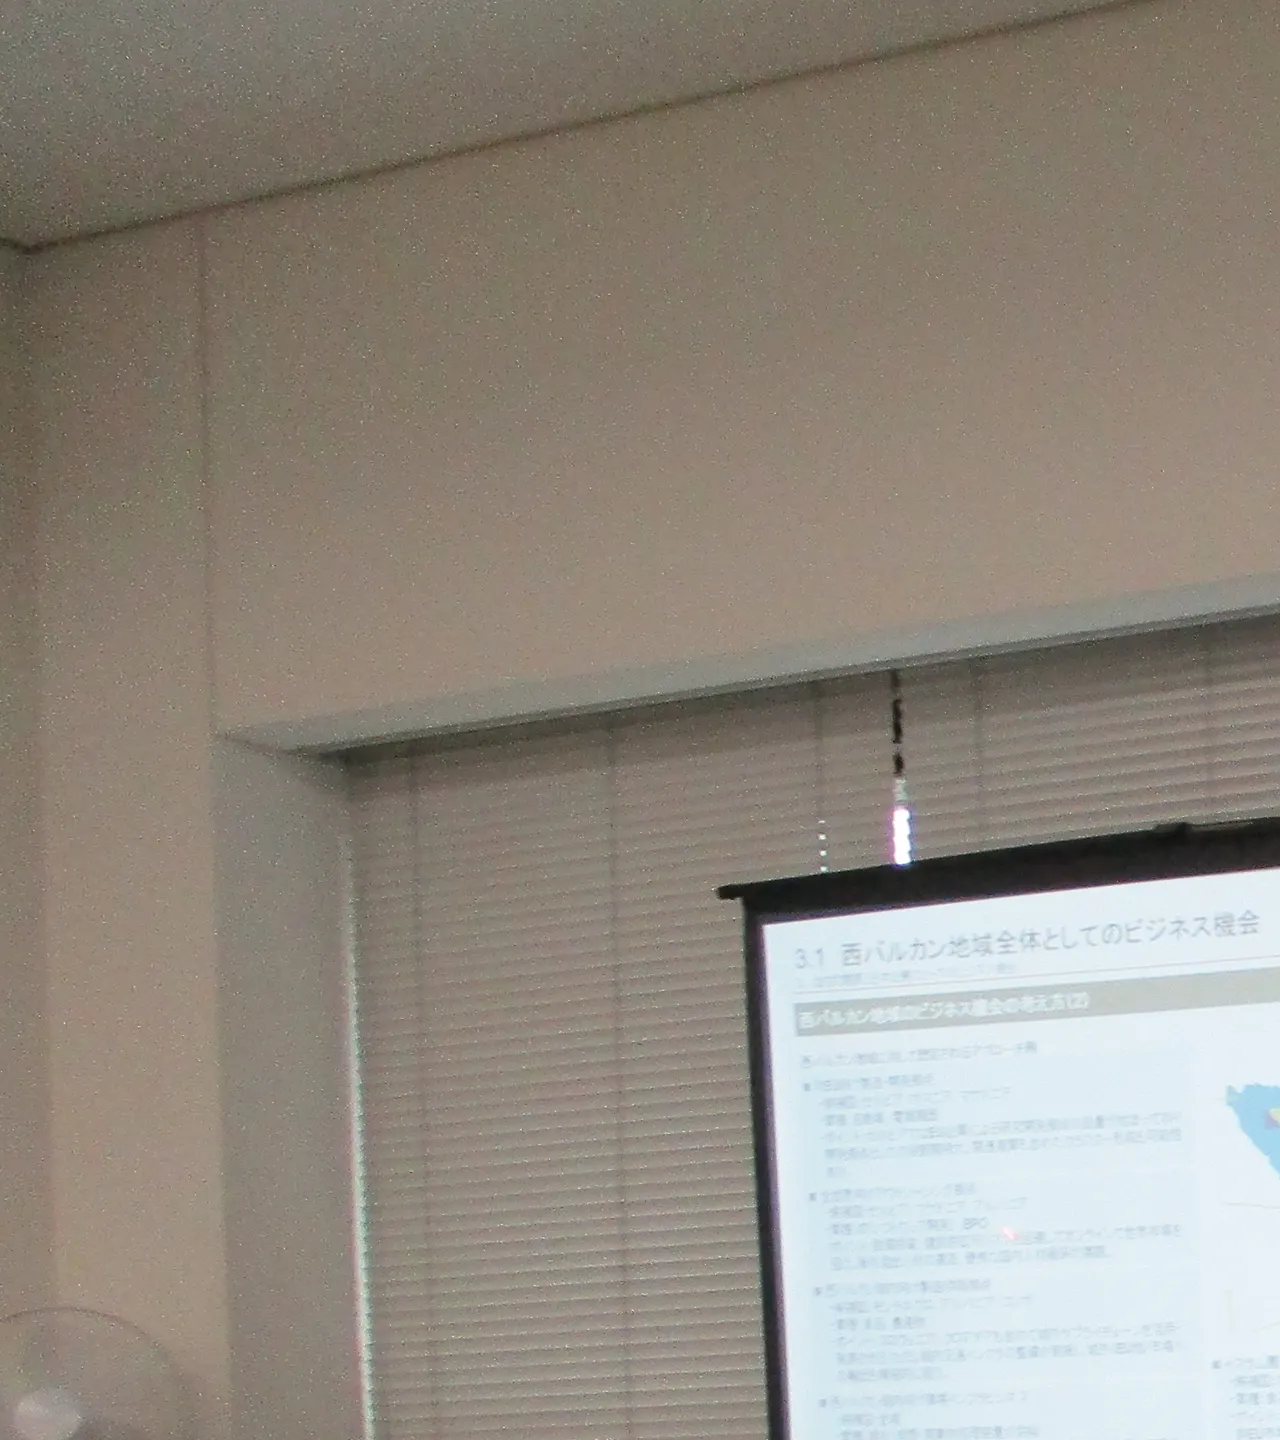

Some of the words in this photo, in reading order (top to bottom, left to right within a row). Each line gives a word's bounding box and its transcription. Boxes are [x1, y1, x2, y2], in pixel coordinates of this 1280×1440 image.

[794, 947, 825, 969] 3.1
[841, 908, 1261, 968] 西バルカン地域全体としてのビジネス機会
